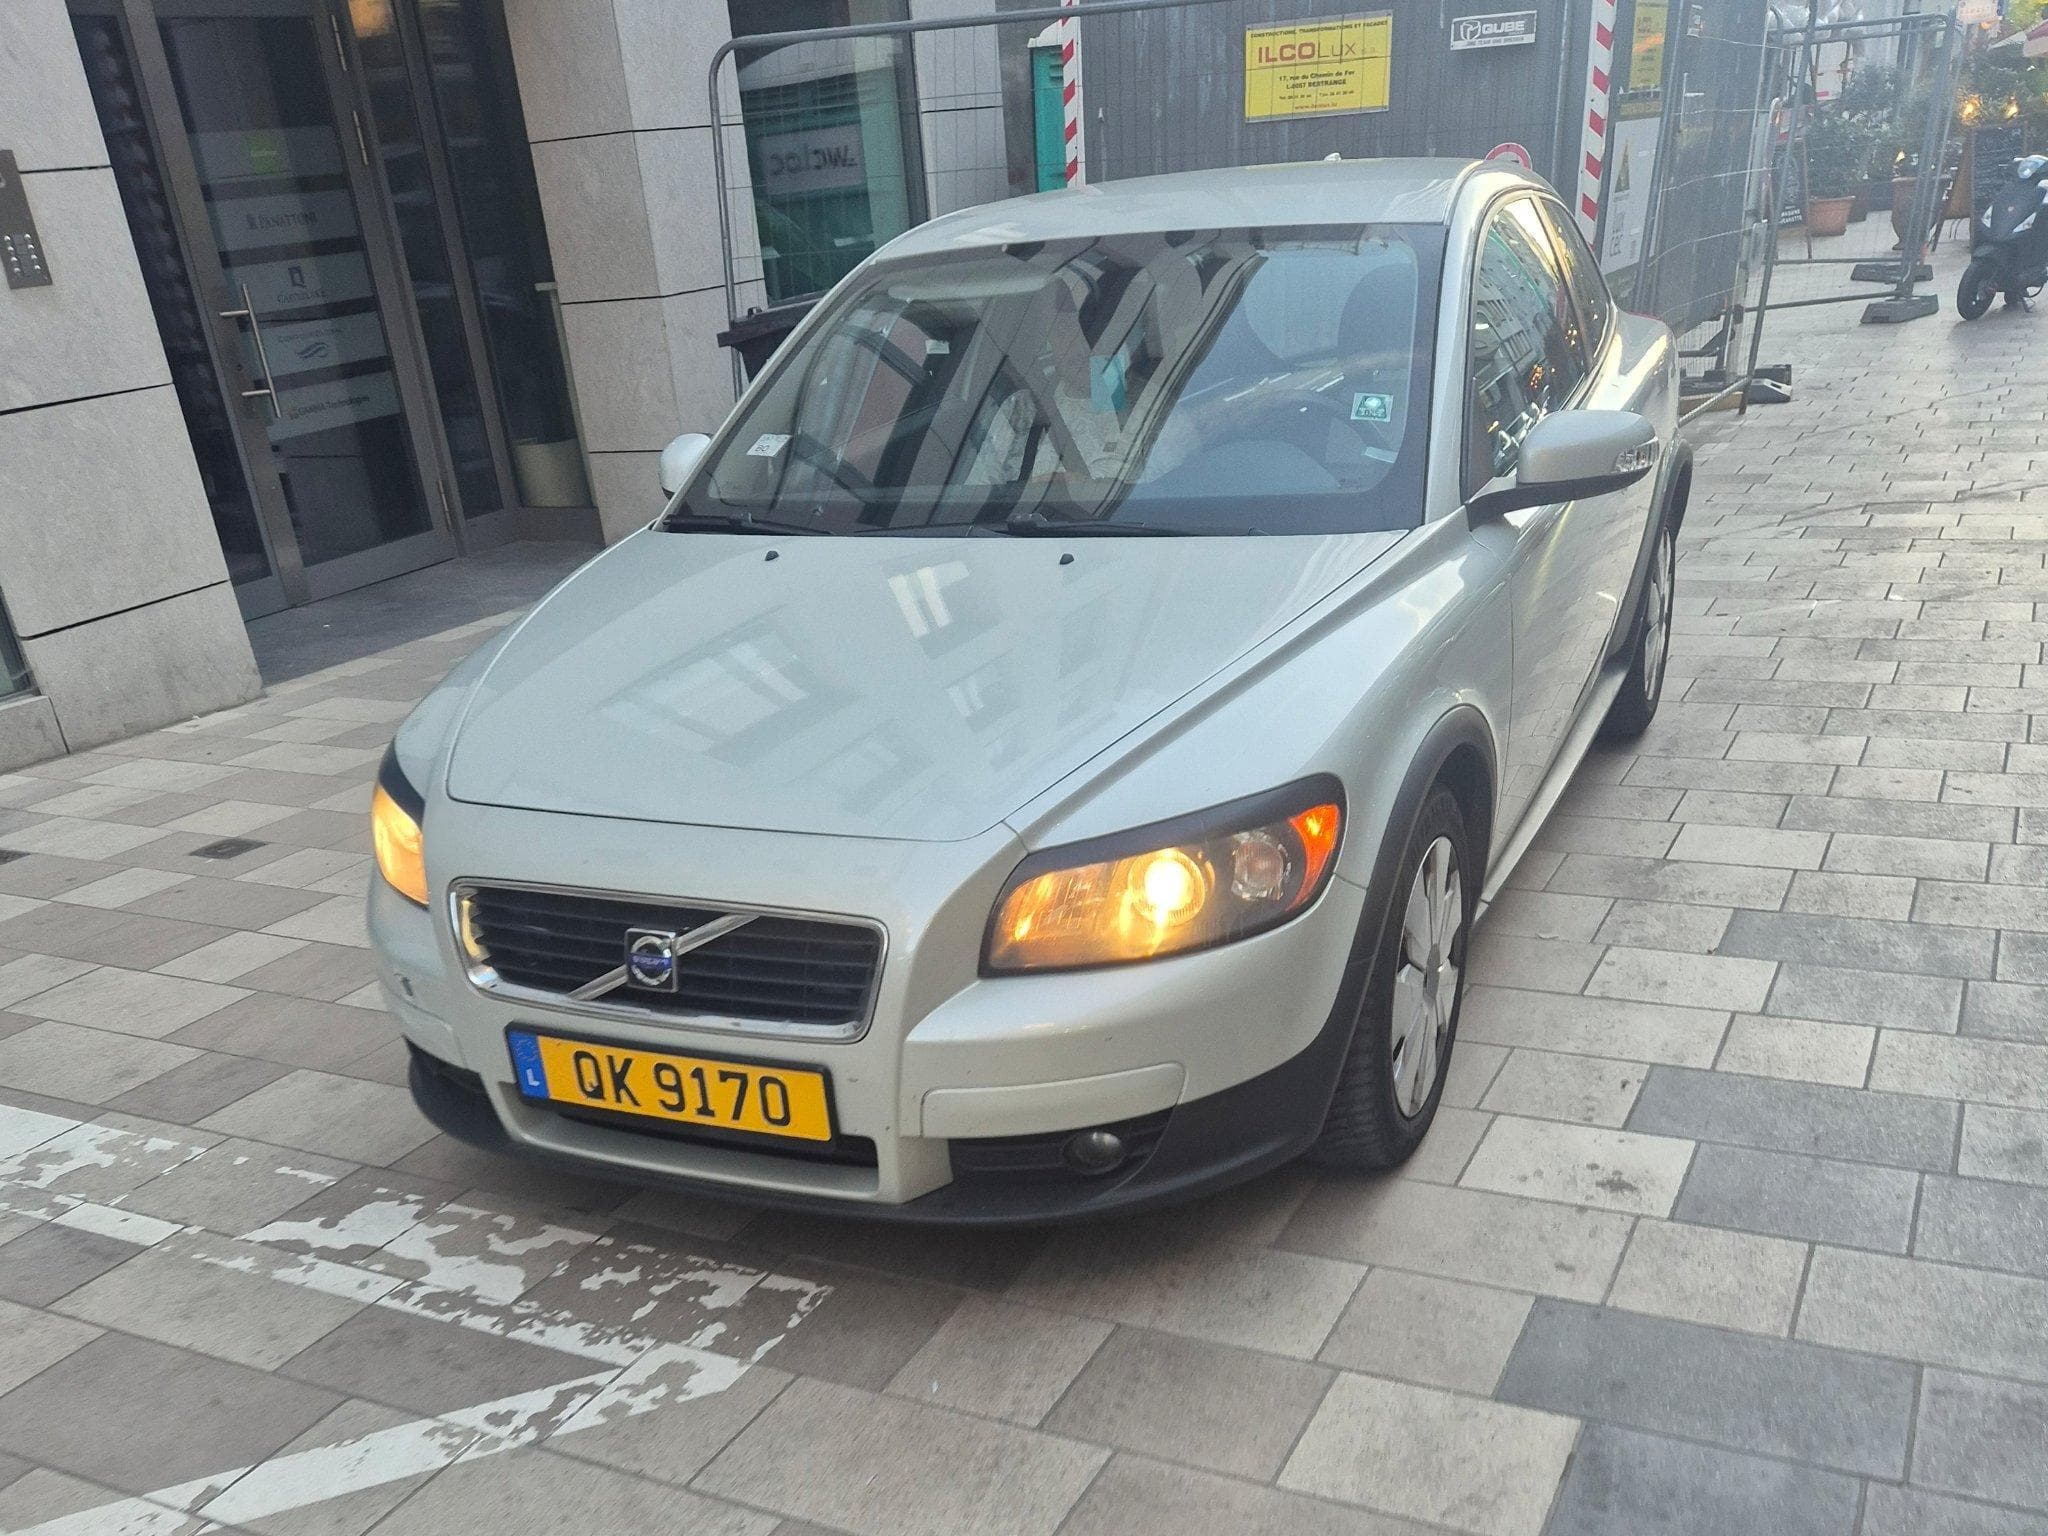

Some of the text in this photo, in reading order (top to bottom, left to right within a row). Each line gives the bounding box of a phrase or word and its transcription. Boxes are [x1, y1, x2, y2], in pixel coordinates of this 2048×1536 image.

[1481, 20, 1526, 35] QUBE
[1310, 71, 1334, 79] Chemin
[526, 1050, 791, 1127] L QK 9170
